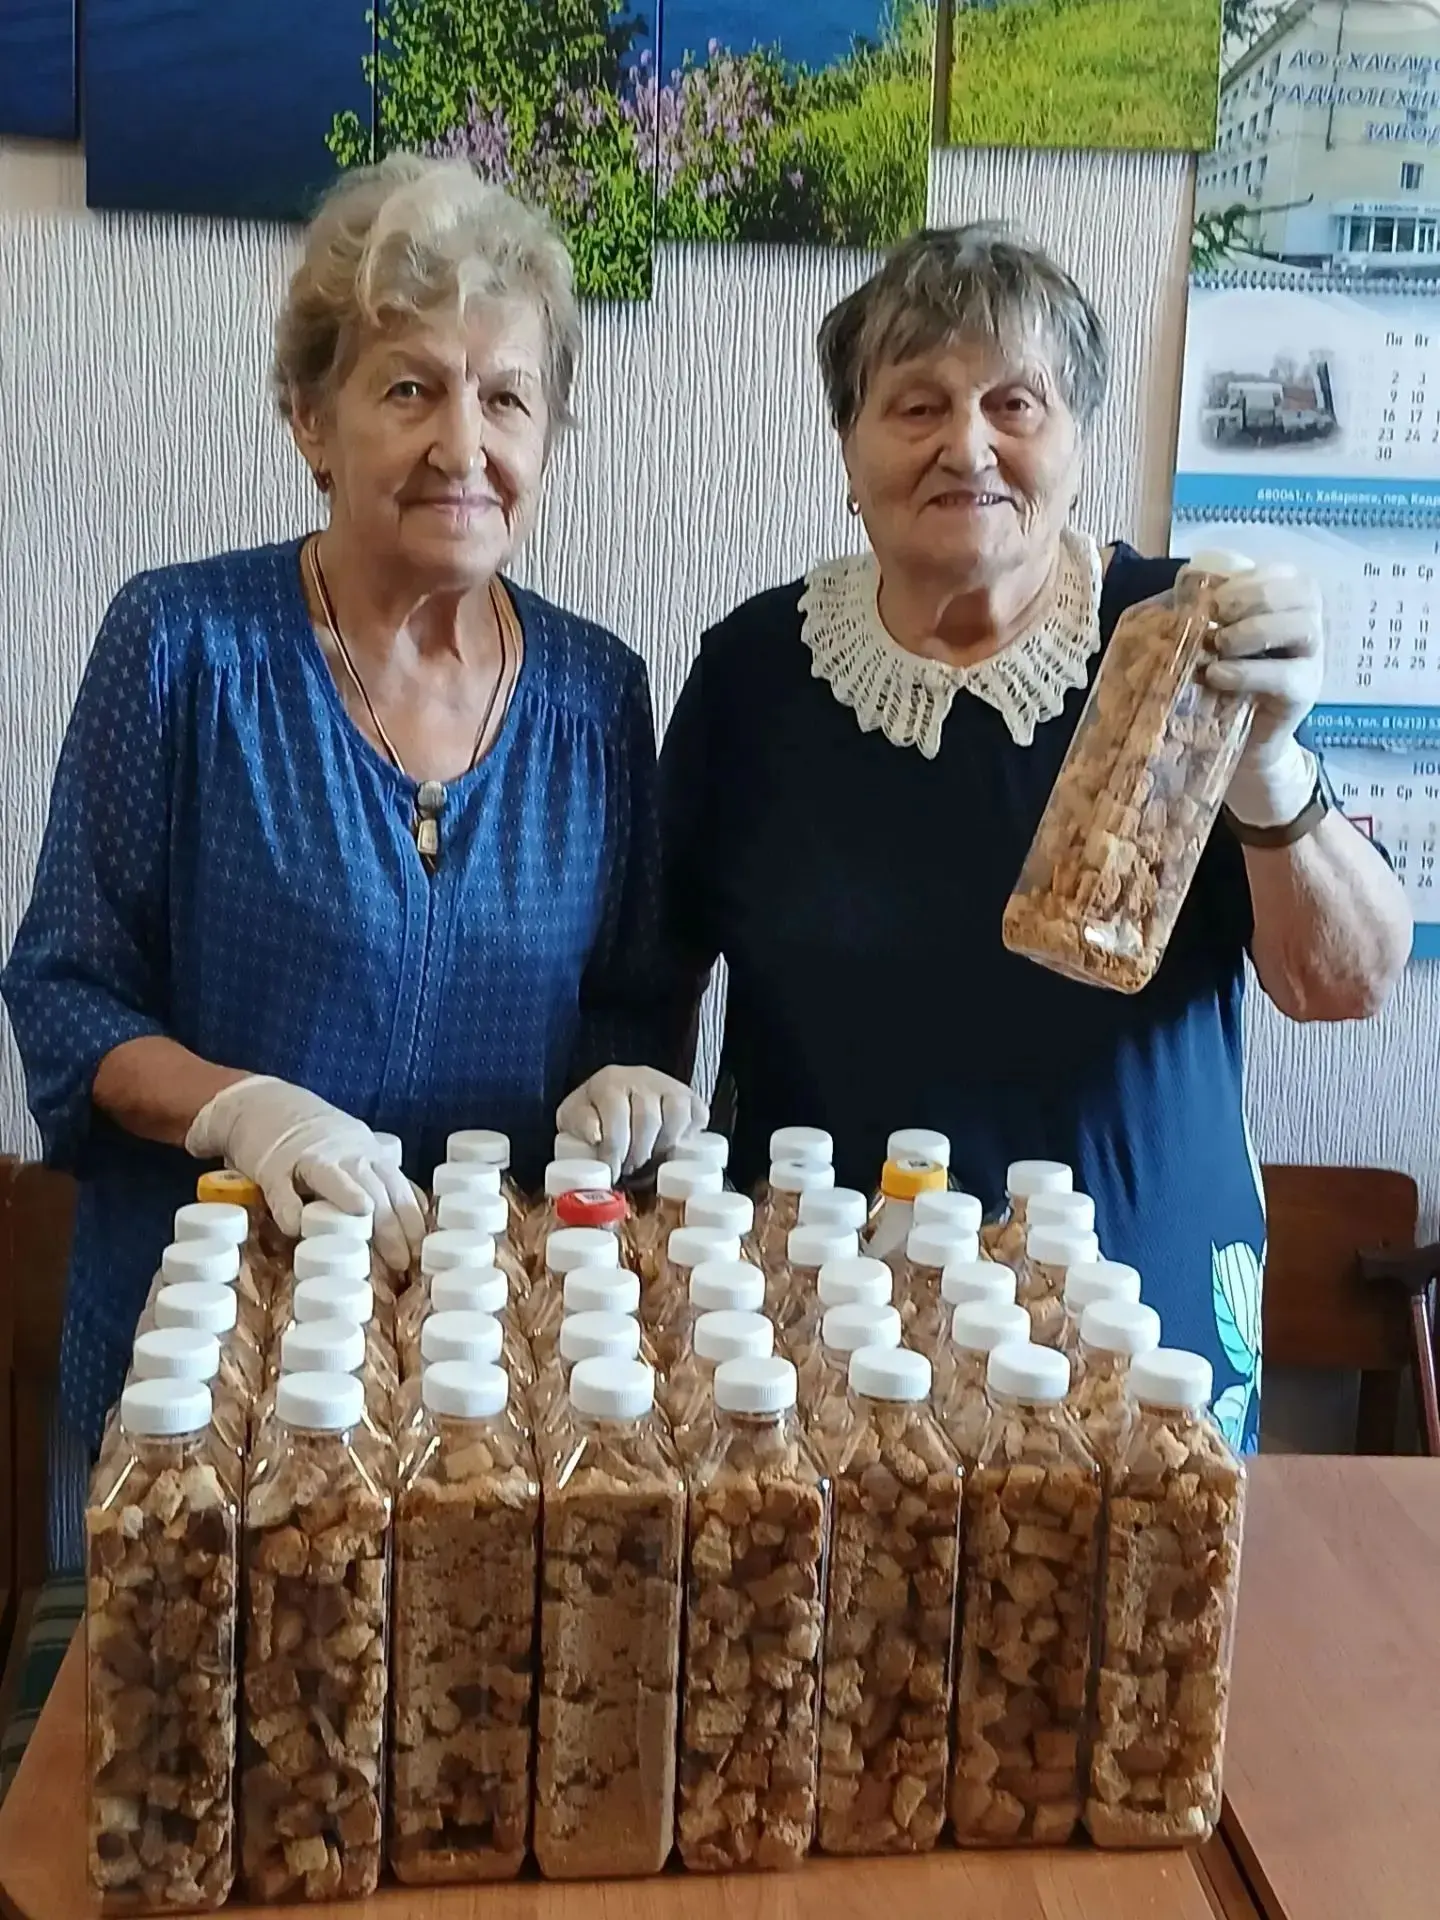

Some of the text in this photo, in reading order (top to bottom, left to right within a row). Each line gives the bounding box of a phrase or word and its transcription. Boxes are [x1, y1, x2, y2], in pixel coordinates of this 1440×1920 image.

[1288, 50, 1325, 69] АО
[1385, 331, 1429, 348] Пн Вт
[1391, 369, 1399, 385] 2
[1390, 389, 1425, 404] 9 10
[1383, 408, 1396, 423] 16
[1410, 408, 1423, 424] 17
[1377, 427, 1395, 442] 23
[1374, 445, 1393, 461] 30
[1363, 561, 1434, 582] Пн Вт Ср
[1369, 599, 1378, 614] 2
[1395, 600, 1404, 615] 3
[1368, 617, 1429, 634] 9 10 11
[1361, 635, 1428, 652] 16 17 18
[1357, 654, 1374, 669] 23
[1409, 655, 1427, 671] 25
[1355, 671, 1372, 688] 30
[1342, 783, 1359, 798] Пн
[1396, 785, 1413, 803] Ср
[1398, 839, 1436, 853] 11 12
[1393, 855, 1434, 870] 18 19
[1416, 873, 1433, 888] 26
